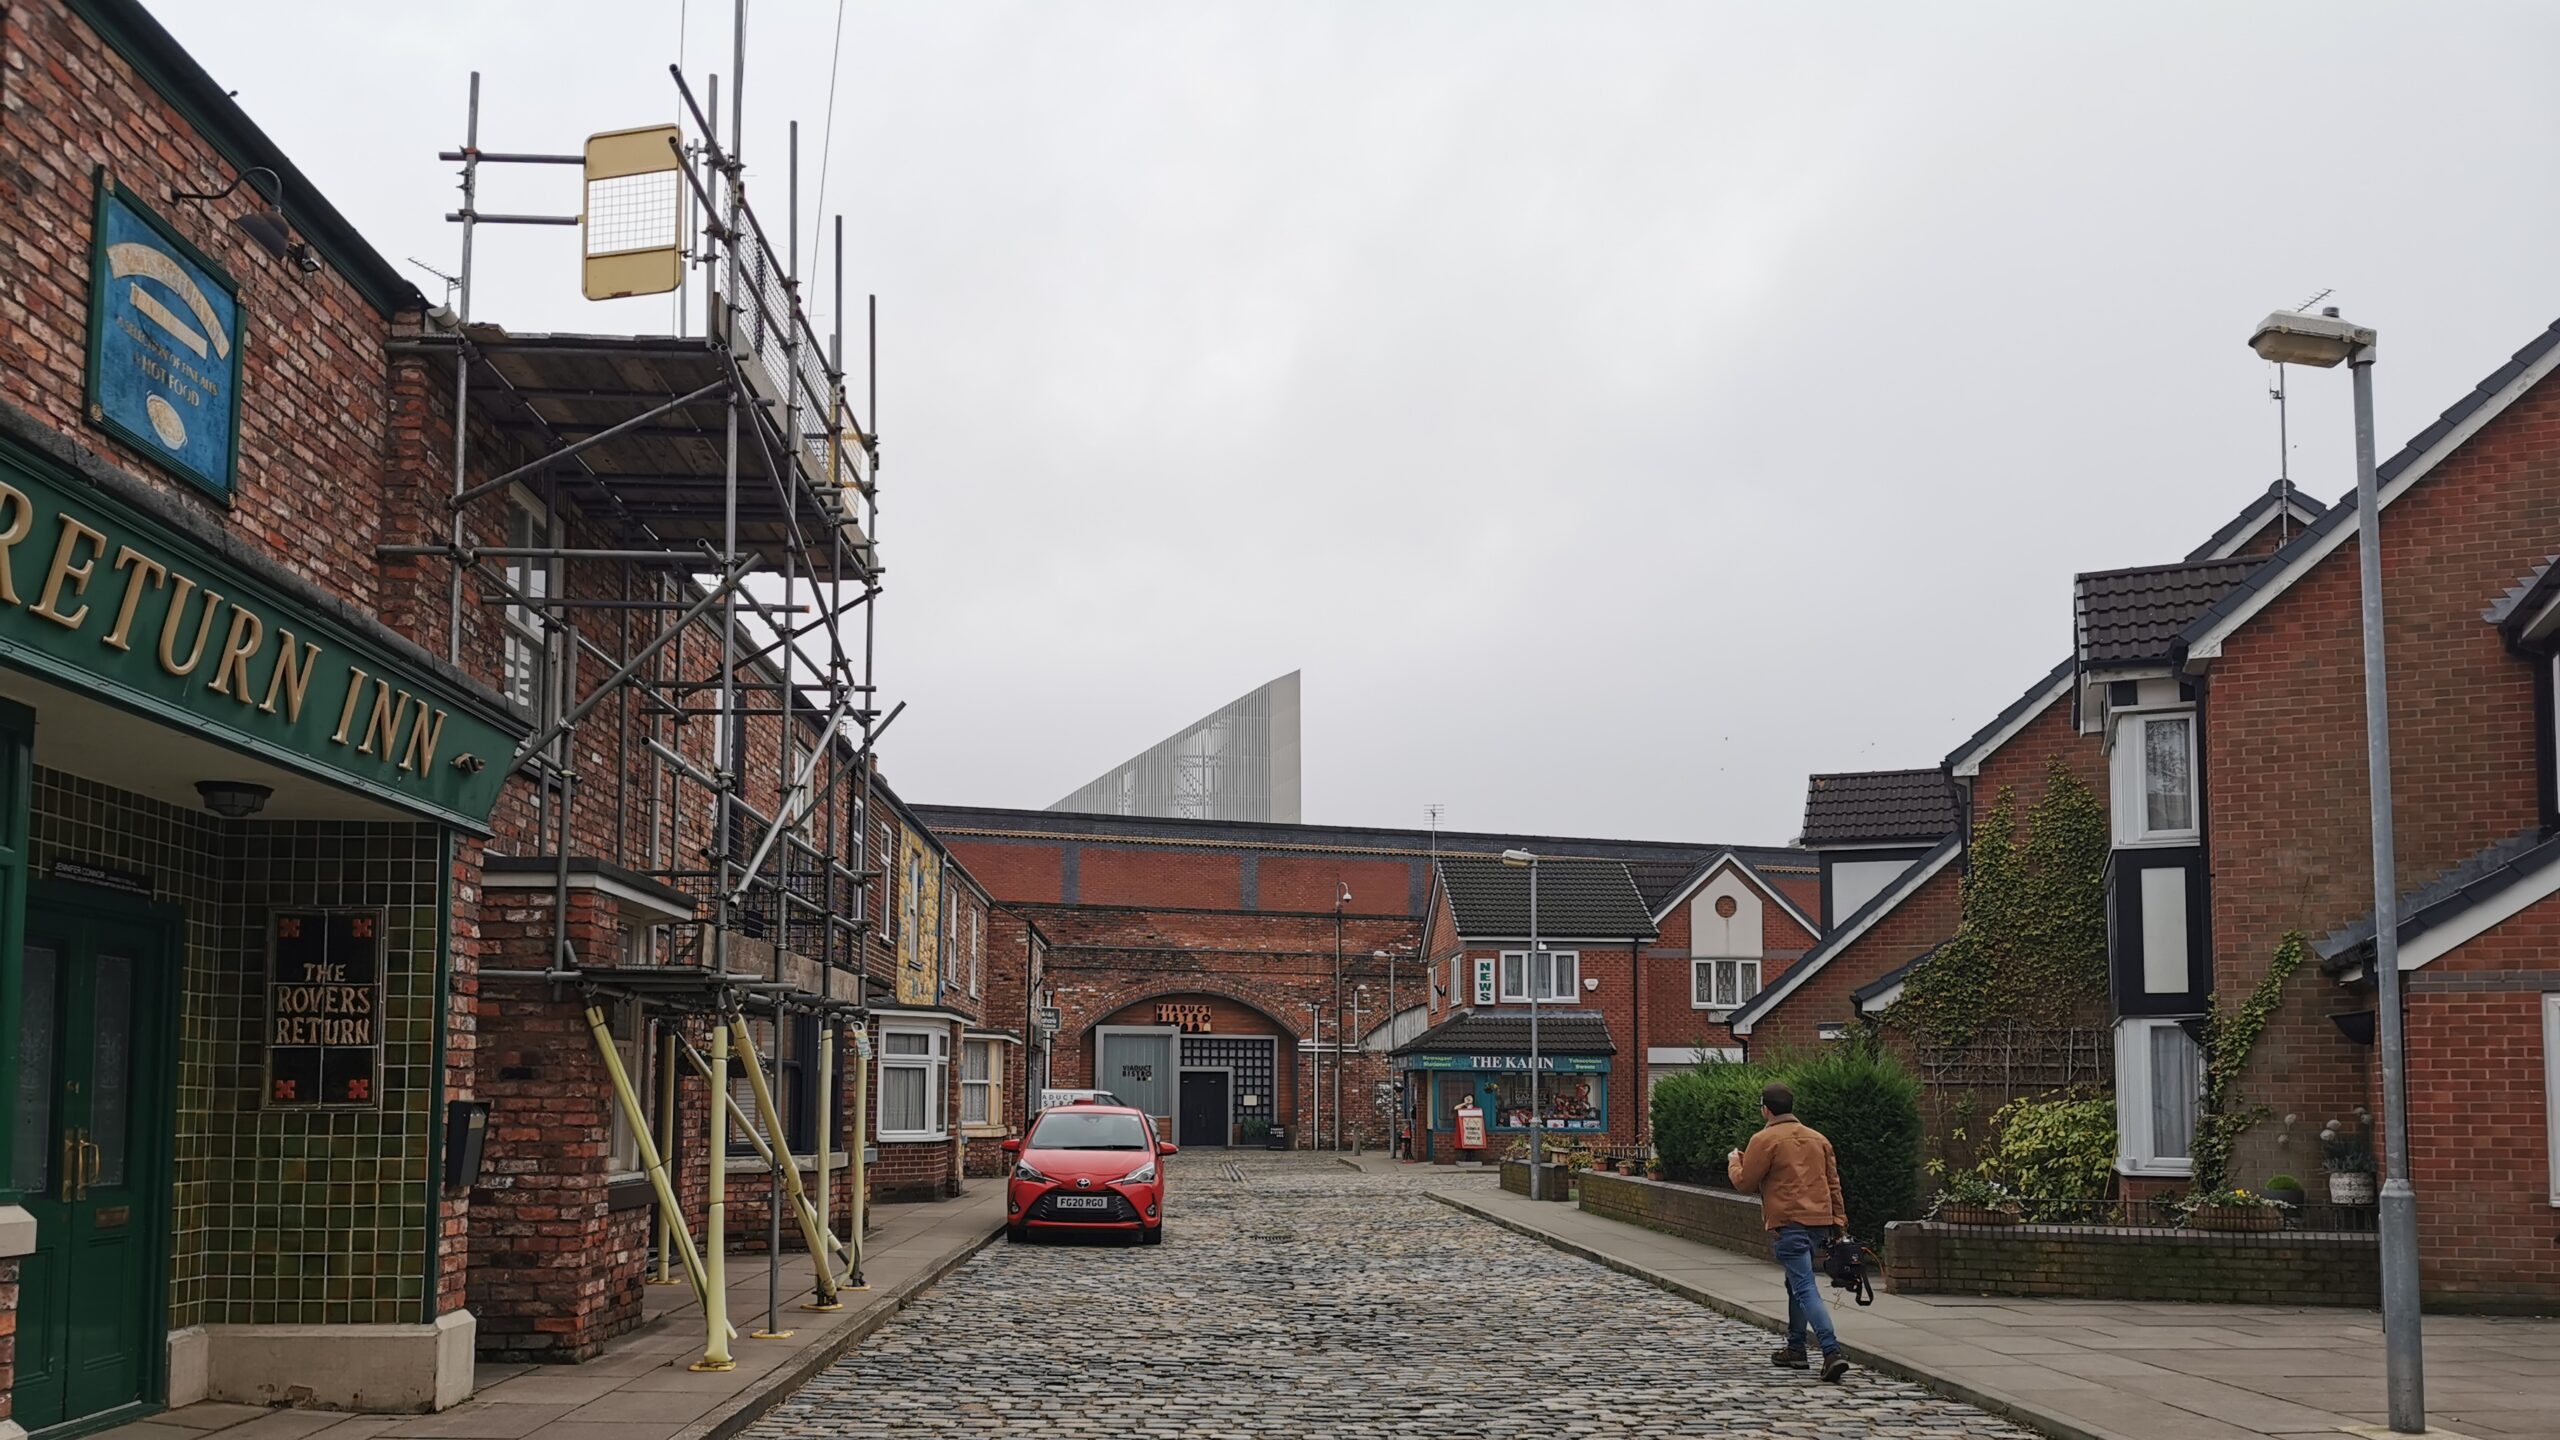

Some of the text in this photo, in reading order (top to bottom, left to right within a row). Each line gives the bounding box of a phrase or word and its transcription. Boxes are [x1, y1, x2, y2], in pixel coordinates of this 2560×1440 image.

[169, 353, 180, 369] OF
[142, 355, 166, 384] HOT
[169, 374, 199, 407] FOOD
[0, 481, 448, 777] RETURN INN
[303, 962, 346, 983] THE
[1479, 962, 1491, 1001] NEWS
[277, 986, 371, 1014] ROVERS
[1157, 1005, 1211, 1014] VIADUCT
[1157, 1013, 1211, 1023] BISTRO
[276, 1017, 370, 1044] RETURN
[1470, 1055, 1502, 1068] THE
[1060, 1198, 1104, 1207] FG20 RGO
